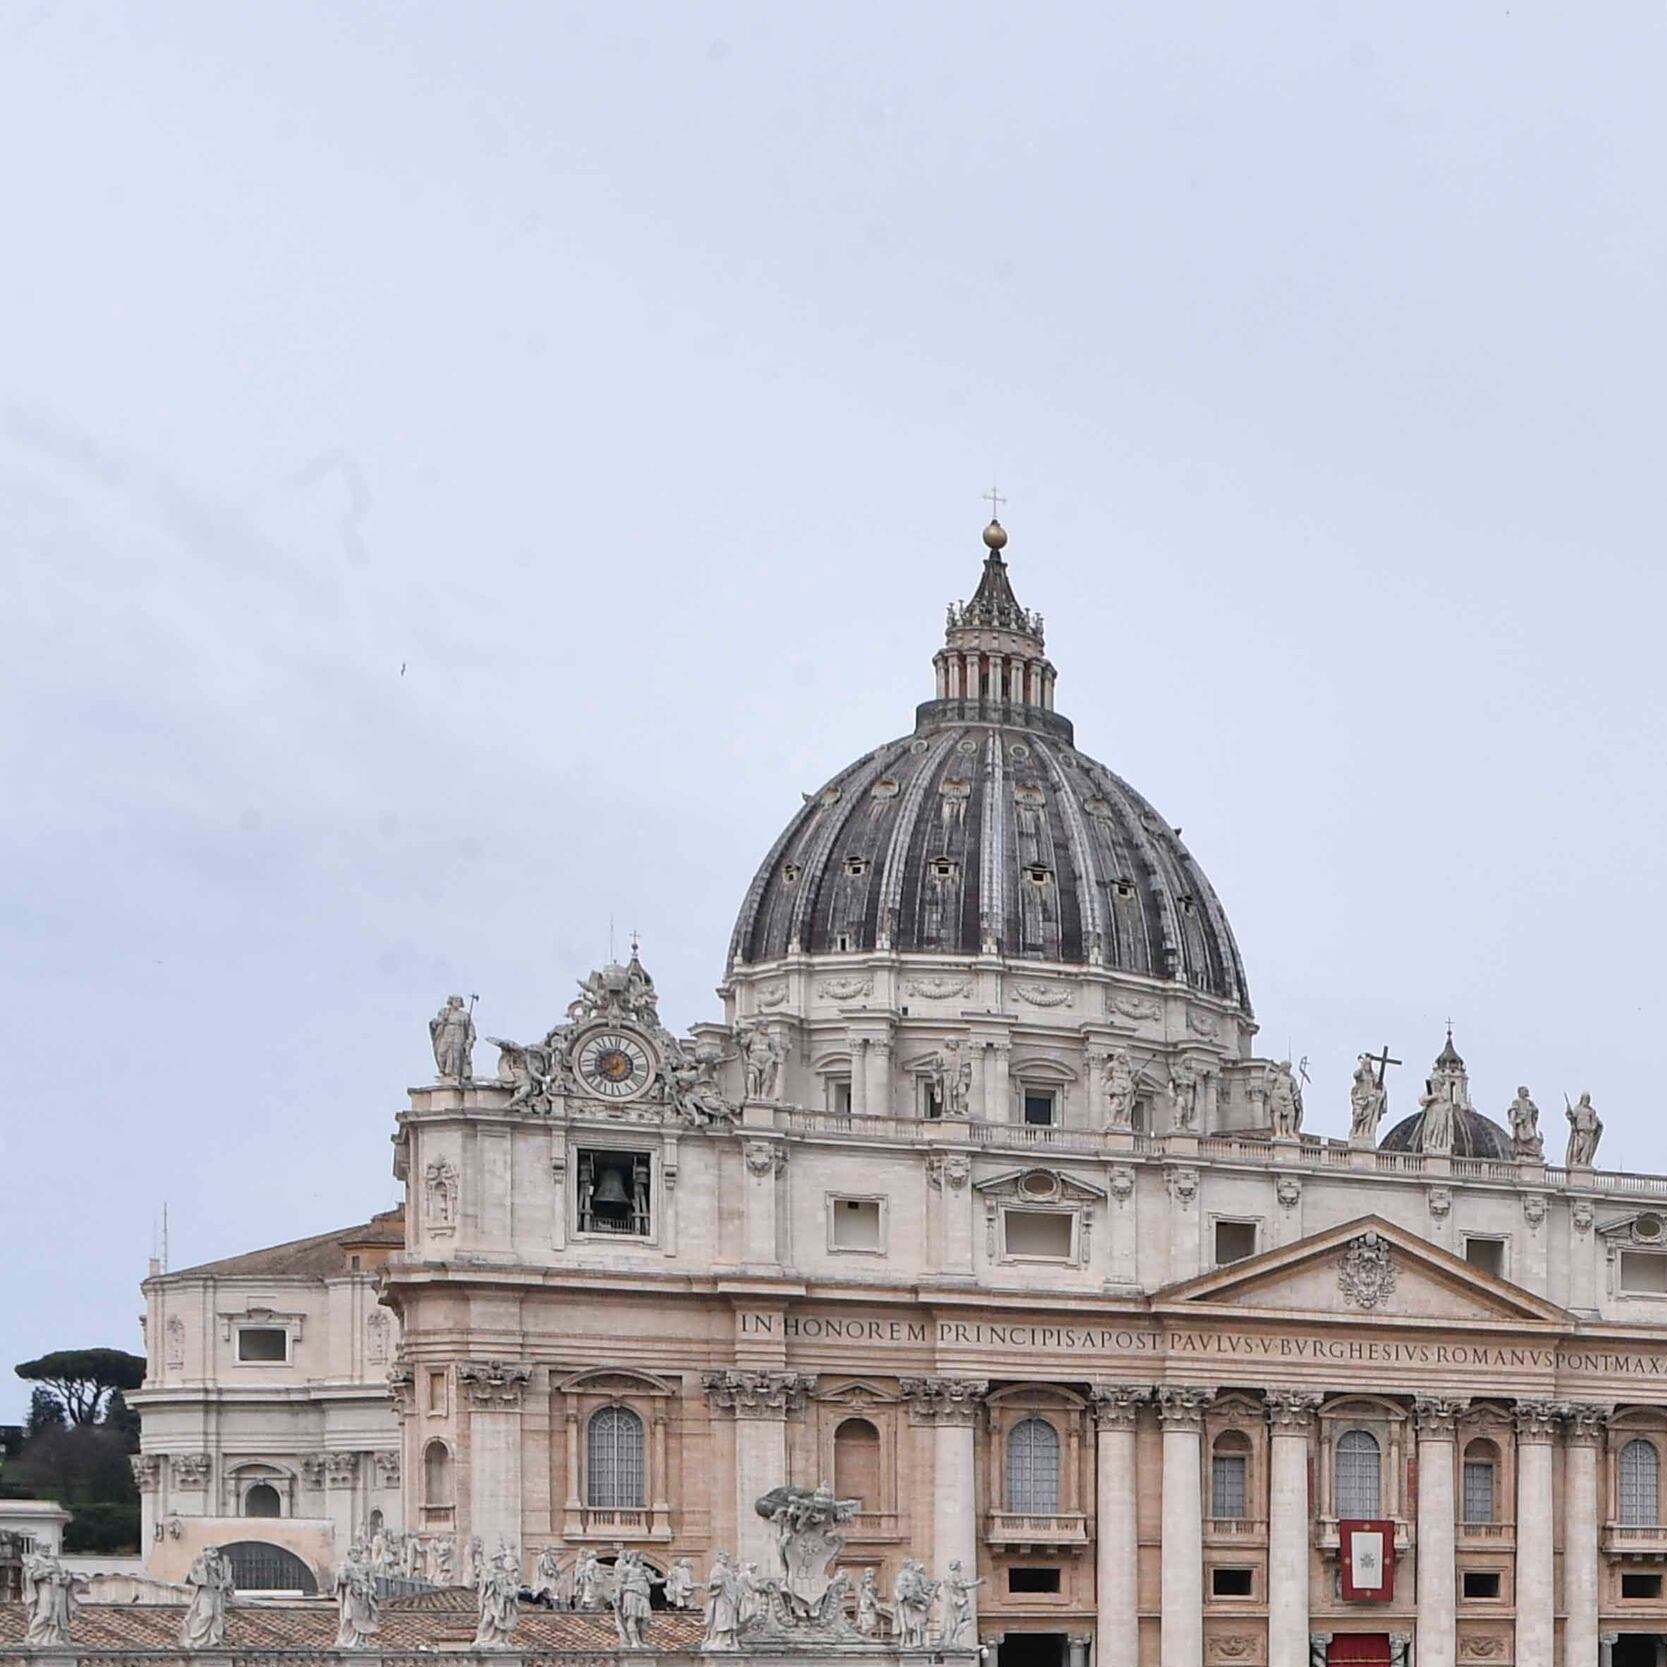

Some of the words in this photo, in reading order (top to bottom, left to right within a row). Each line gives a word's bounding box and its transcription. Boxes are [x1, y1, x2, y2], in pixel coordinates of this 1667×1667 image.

[740, 1314, 772, 1333] IN
[784, 1317, 926, 1342] HONOREM
[939, 1323, 1076, 1347] PRINCIPIS
[1079, 1330, 1162, 1350] APOST
[1170, 1332, 1254, 1354] PAVLVS
[1280, 1338, 1429, 1362] BVRGHESIVS
[1437, 1345, 1553, 1367] ROMANVS
[1555, 1352, 1613, 1371] PONT
[1614, 1355, 1660, 1374] MAX
